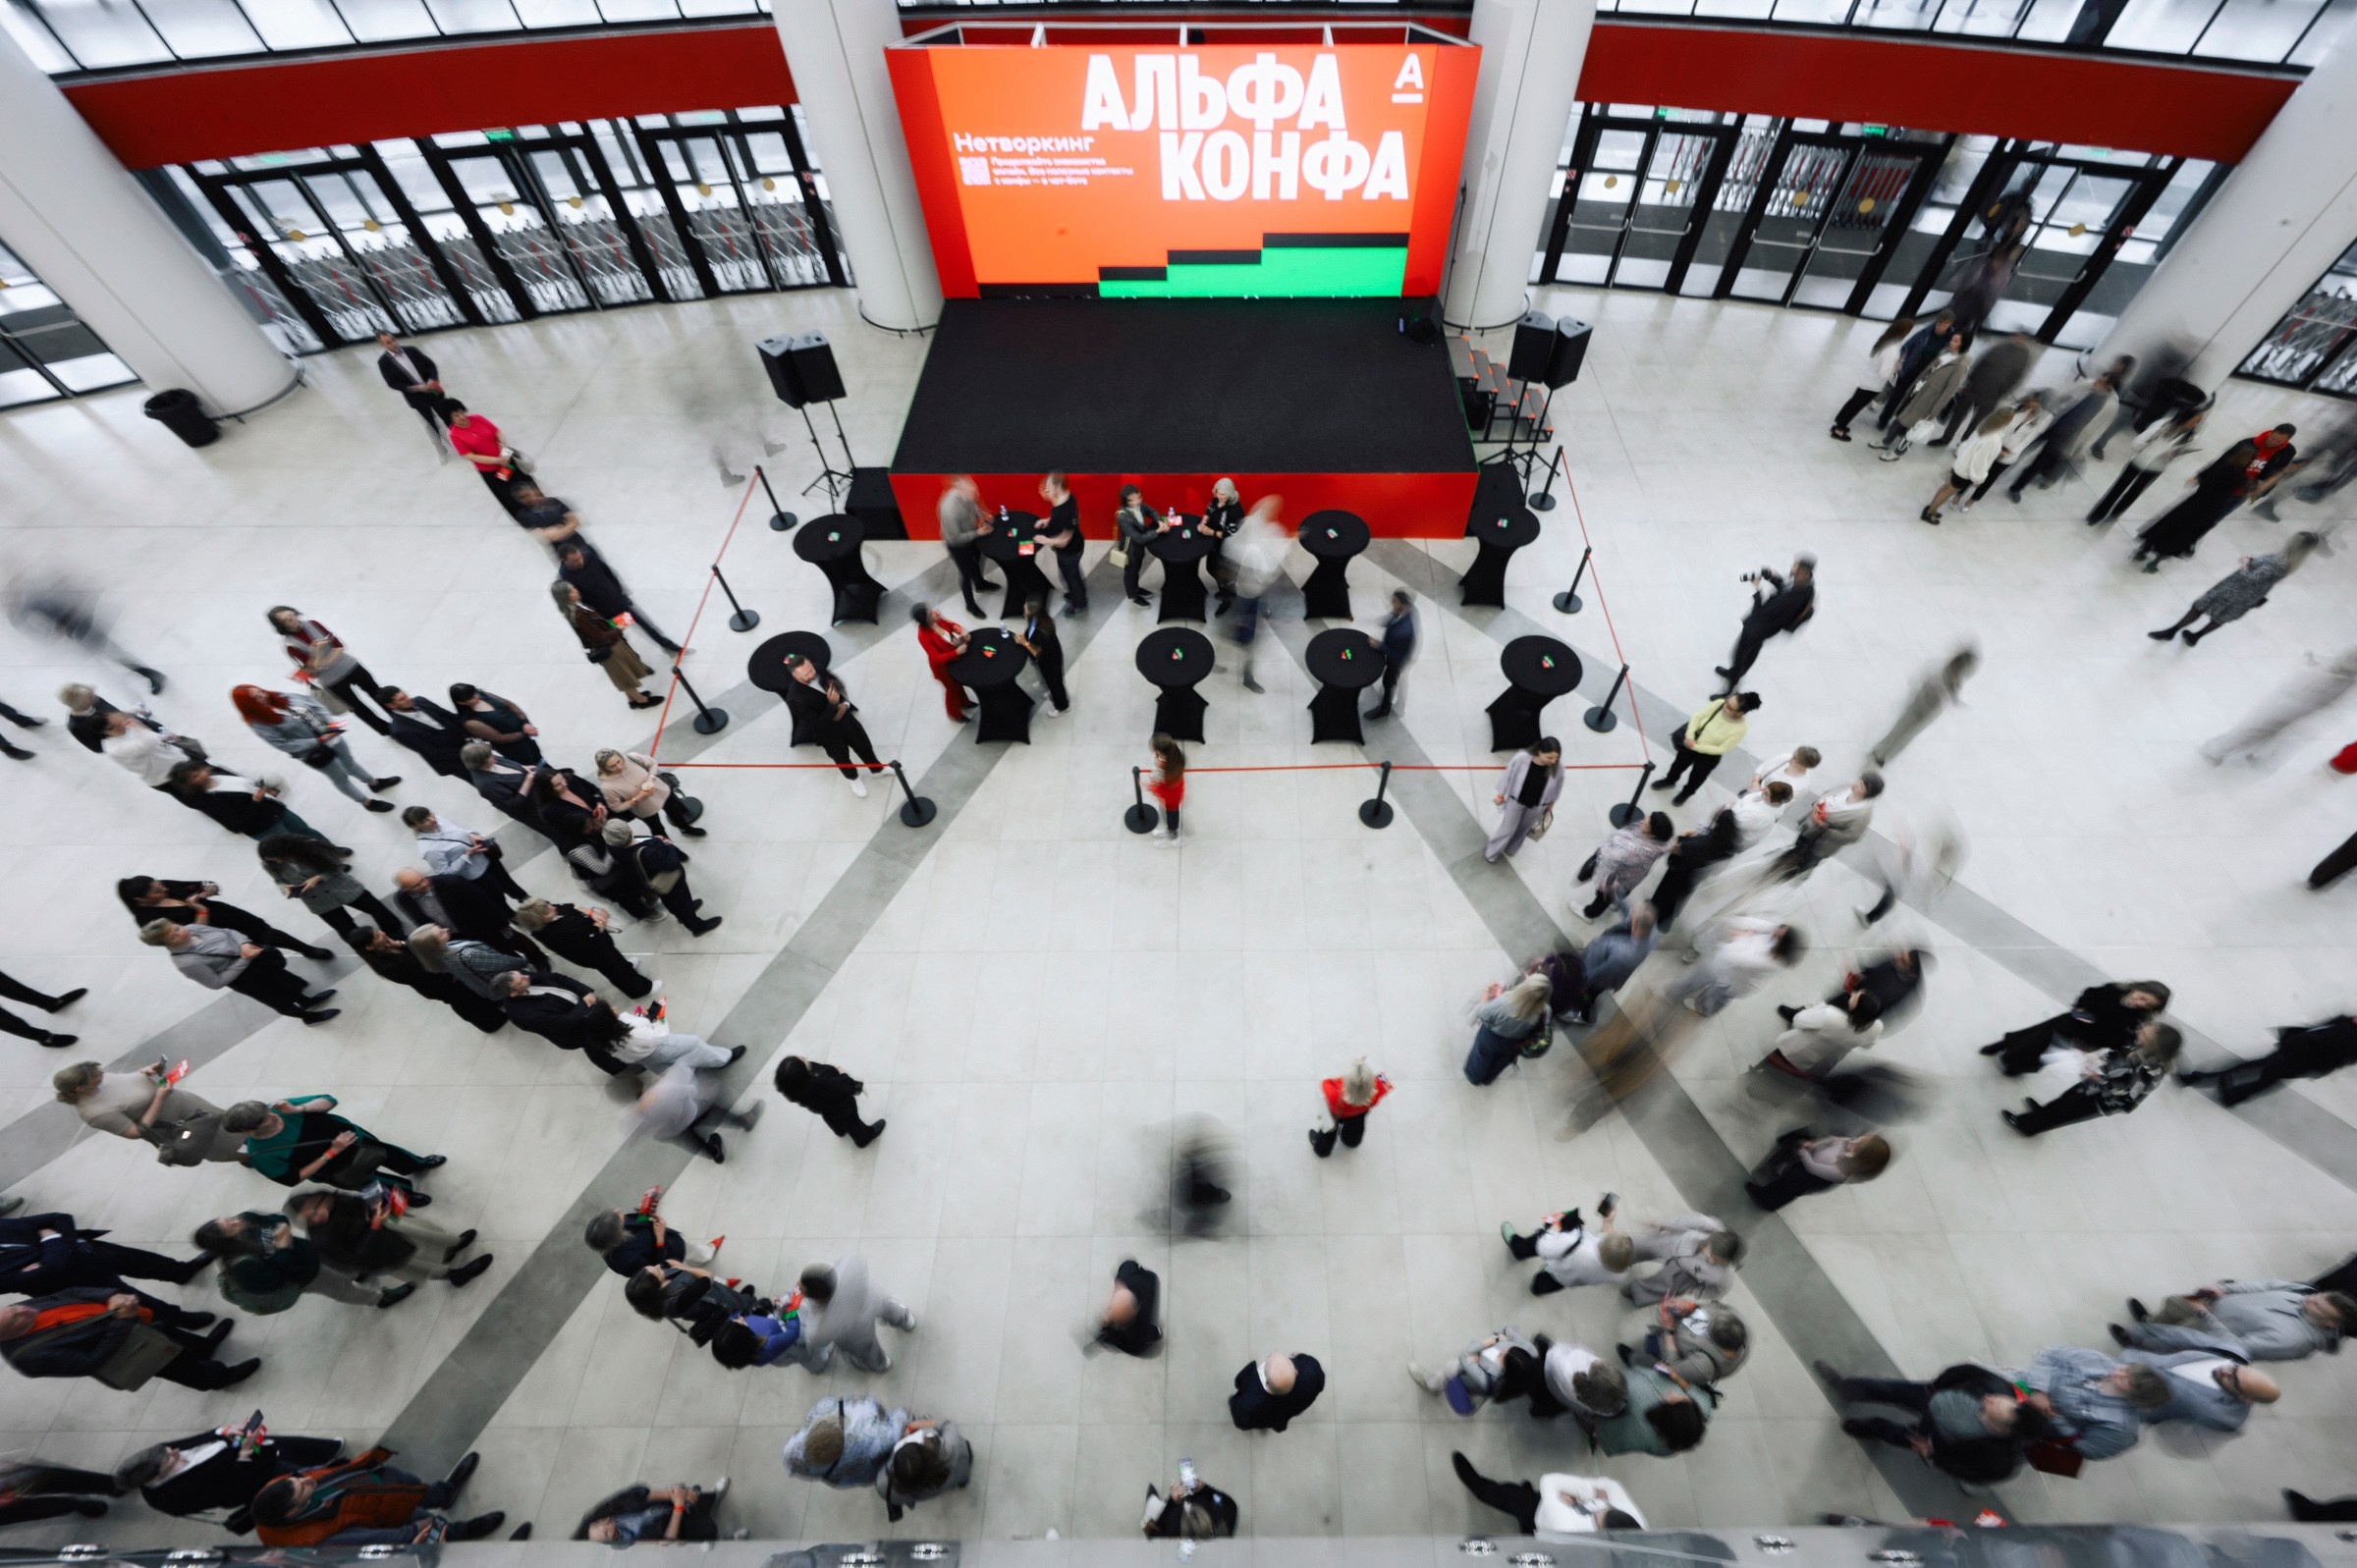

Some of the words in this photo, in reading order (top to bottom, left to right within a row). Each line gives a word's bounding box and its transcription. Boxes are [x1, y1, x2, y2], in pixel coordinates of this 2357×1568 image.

[1081, 53, 1346, 132] АЛЬФА
[953, 132, 1095, 156] Нетворкинг
[1159, 131, 1409, 201] КОНФА
